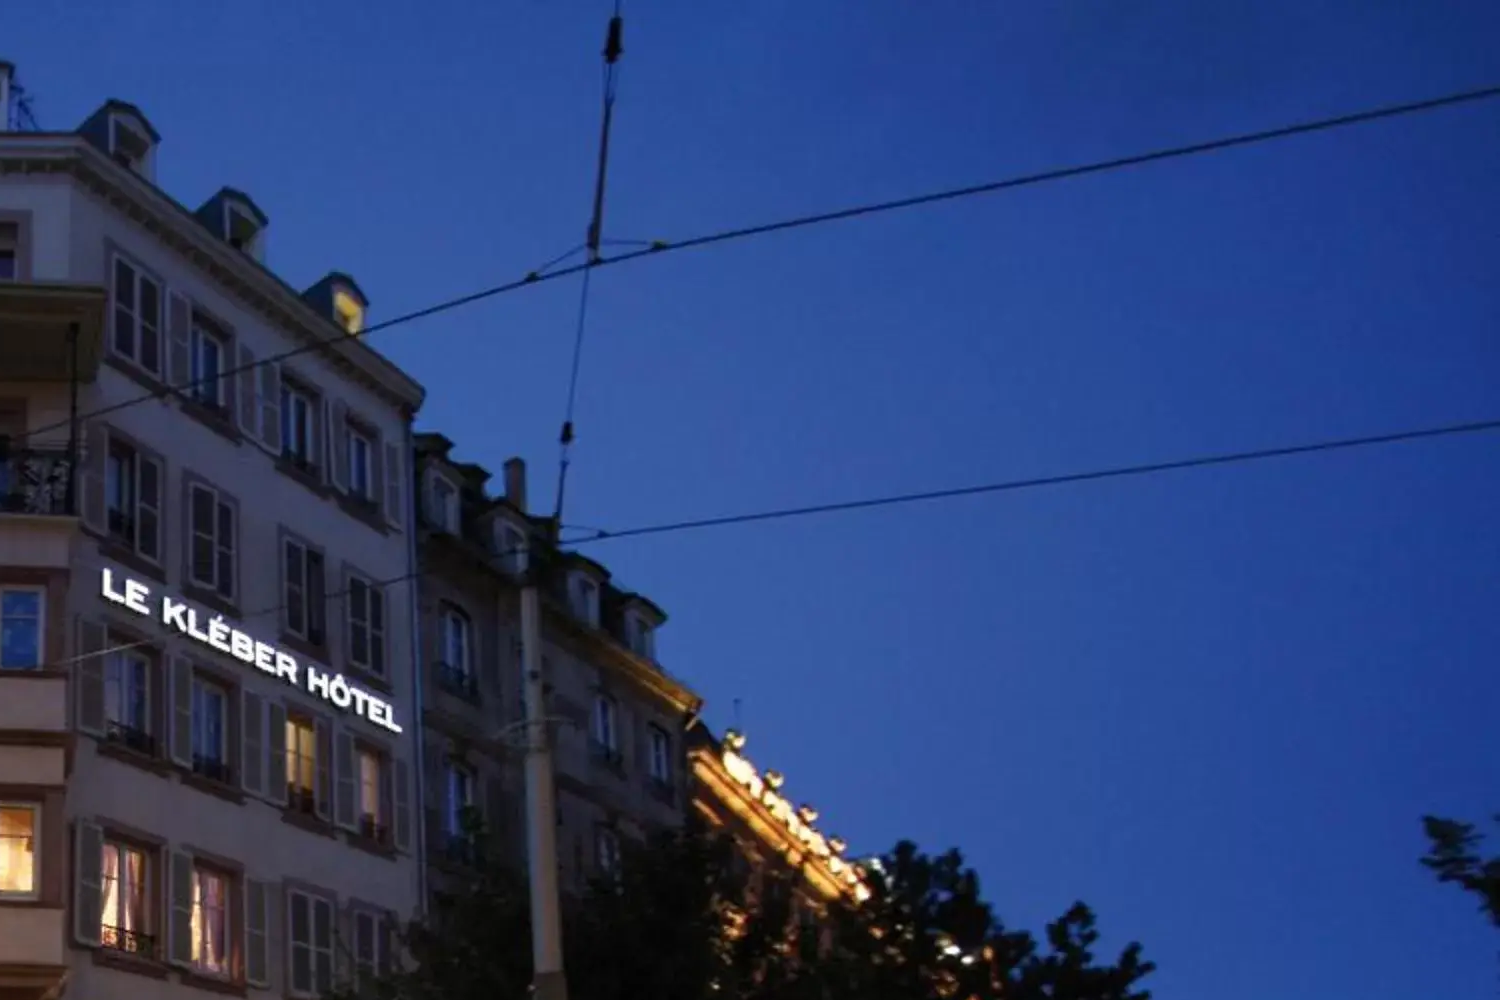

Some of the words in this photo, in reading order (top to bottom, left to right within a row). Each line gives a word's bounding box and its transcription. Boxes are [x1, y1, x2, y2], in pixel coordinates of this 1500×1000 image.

[102, 568, 150, 615] LE
[162, 596, 298, 685] KLÉBER
[307, 665, 403, 734] HÔTEL
